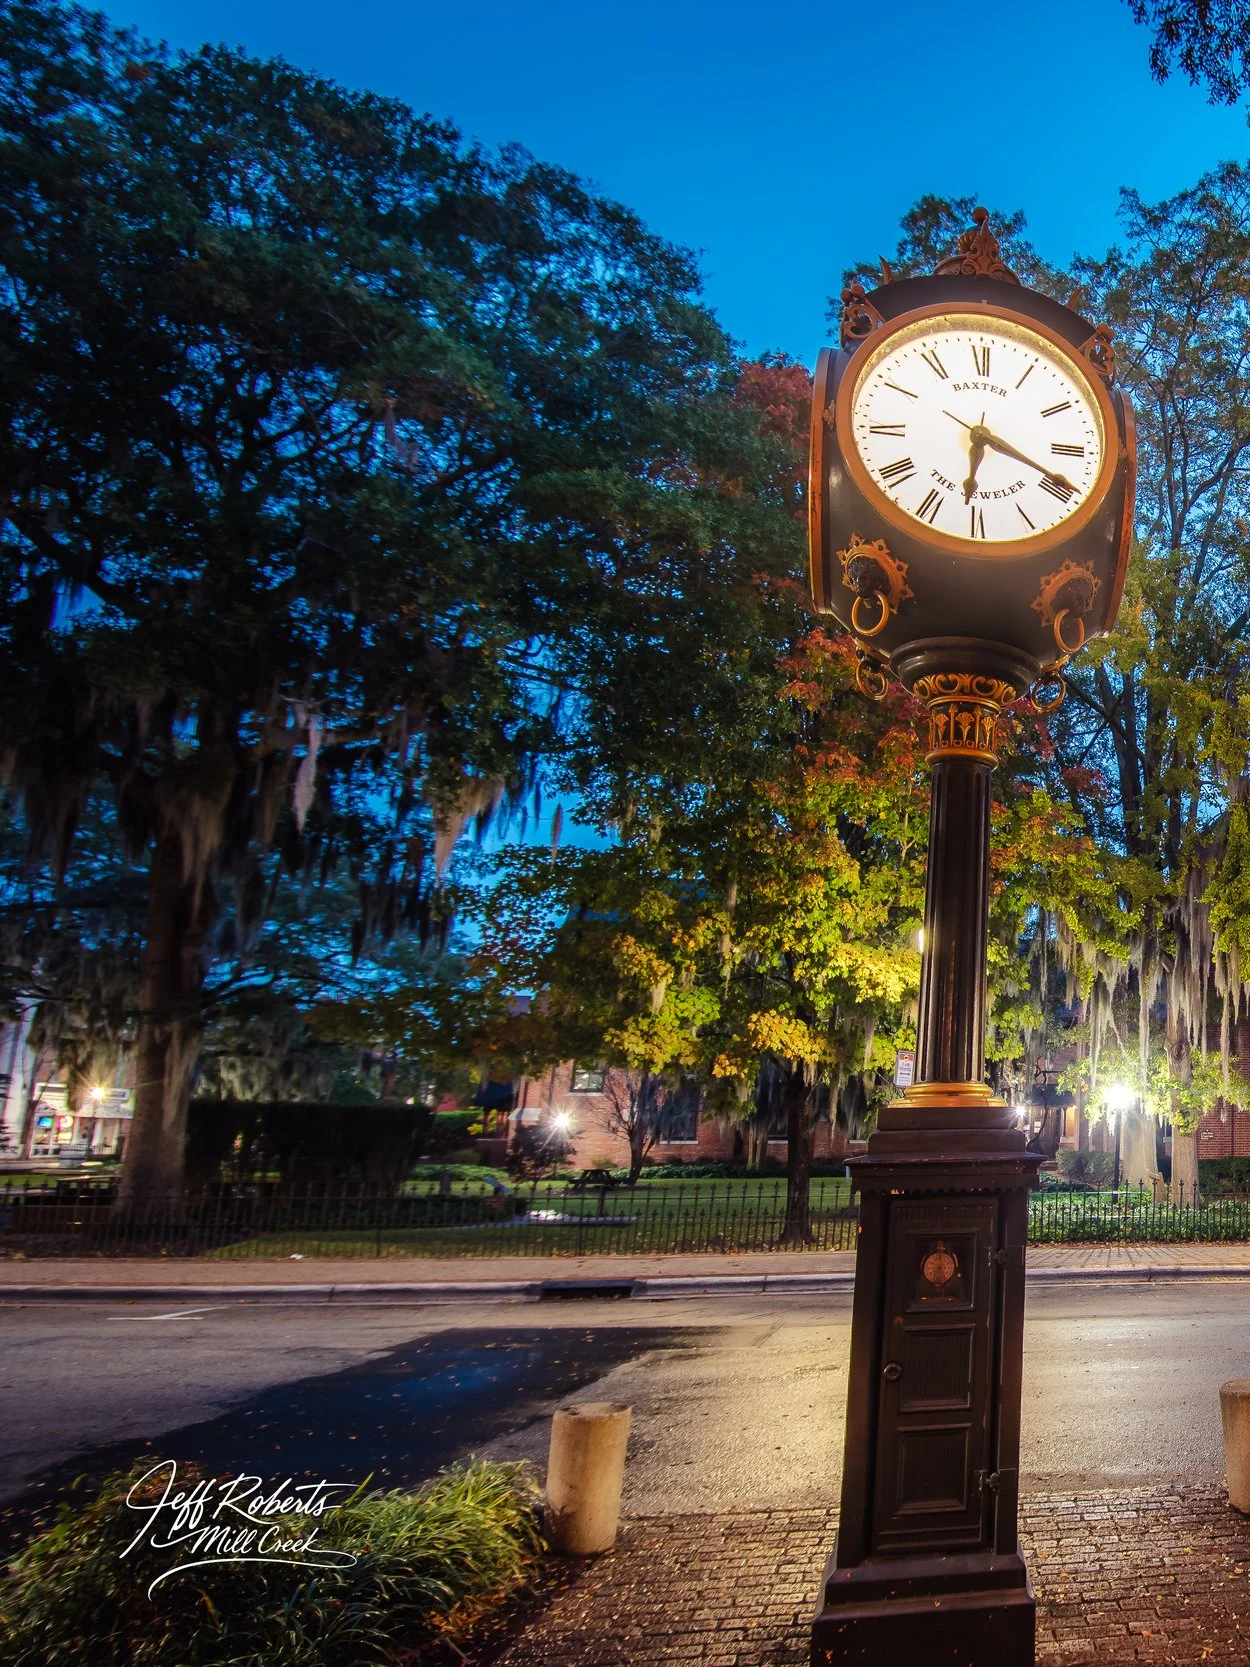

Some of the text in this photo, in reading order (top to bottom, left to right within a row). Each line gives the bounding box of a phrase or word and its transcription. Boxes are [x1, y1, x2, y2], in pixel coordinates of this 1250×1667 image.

[1015, 364, 1034, 390] I
[952, 382, 1007, 397] BAXTER
[1040, 401, 1072, 418] II
[1051, 443, 1084, 457] III
[930, 469, 956, 491] THE
[1015, 502, 1036, 532] V
